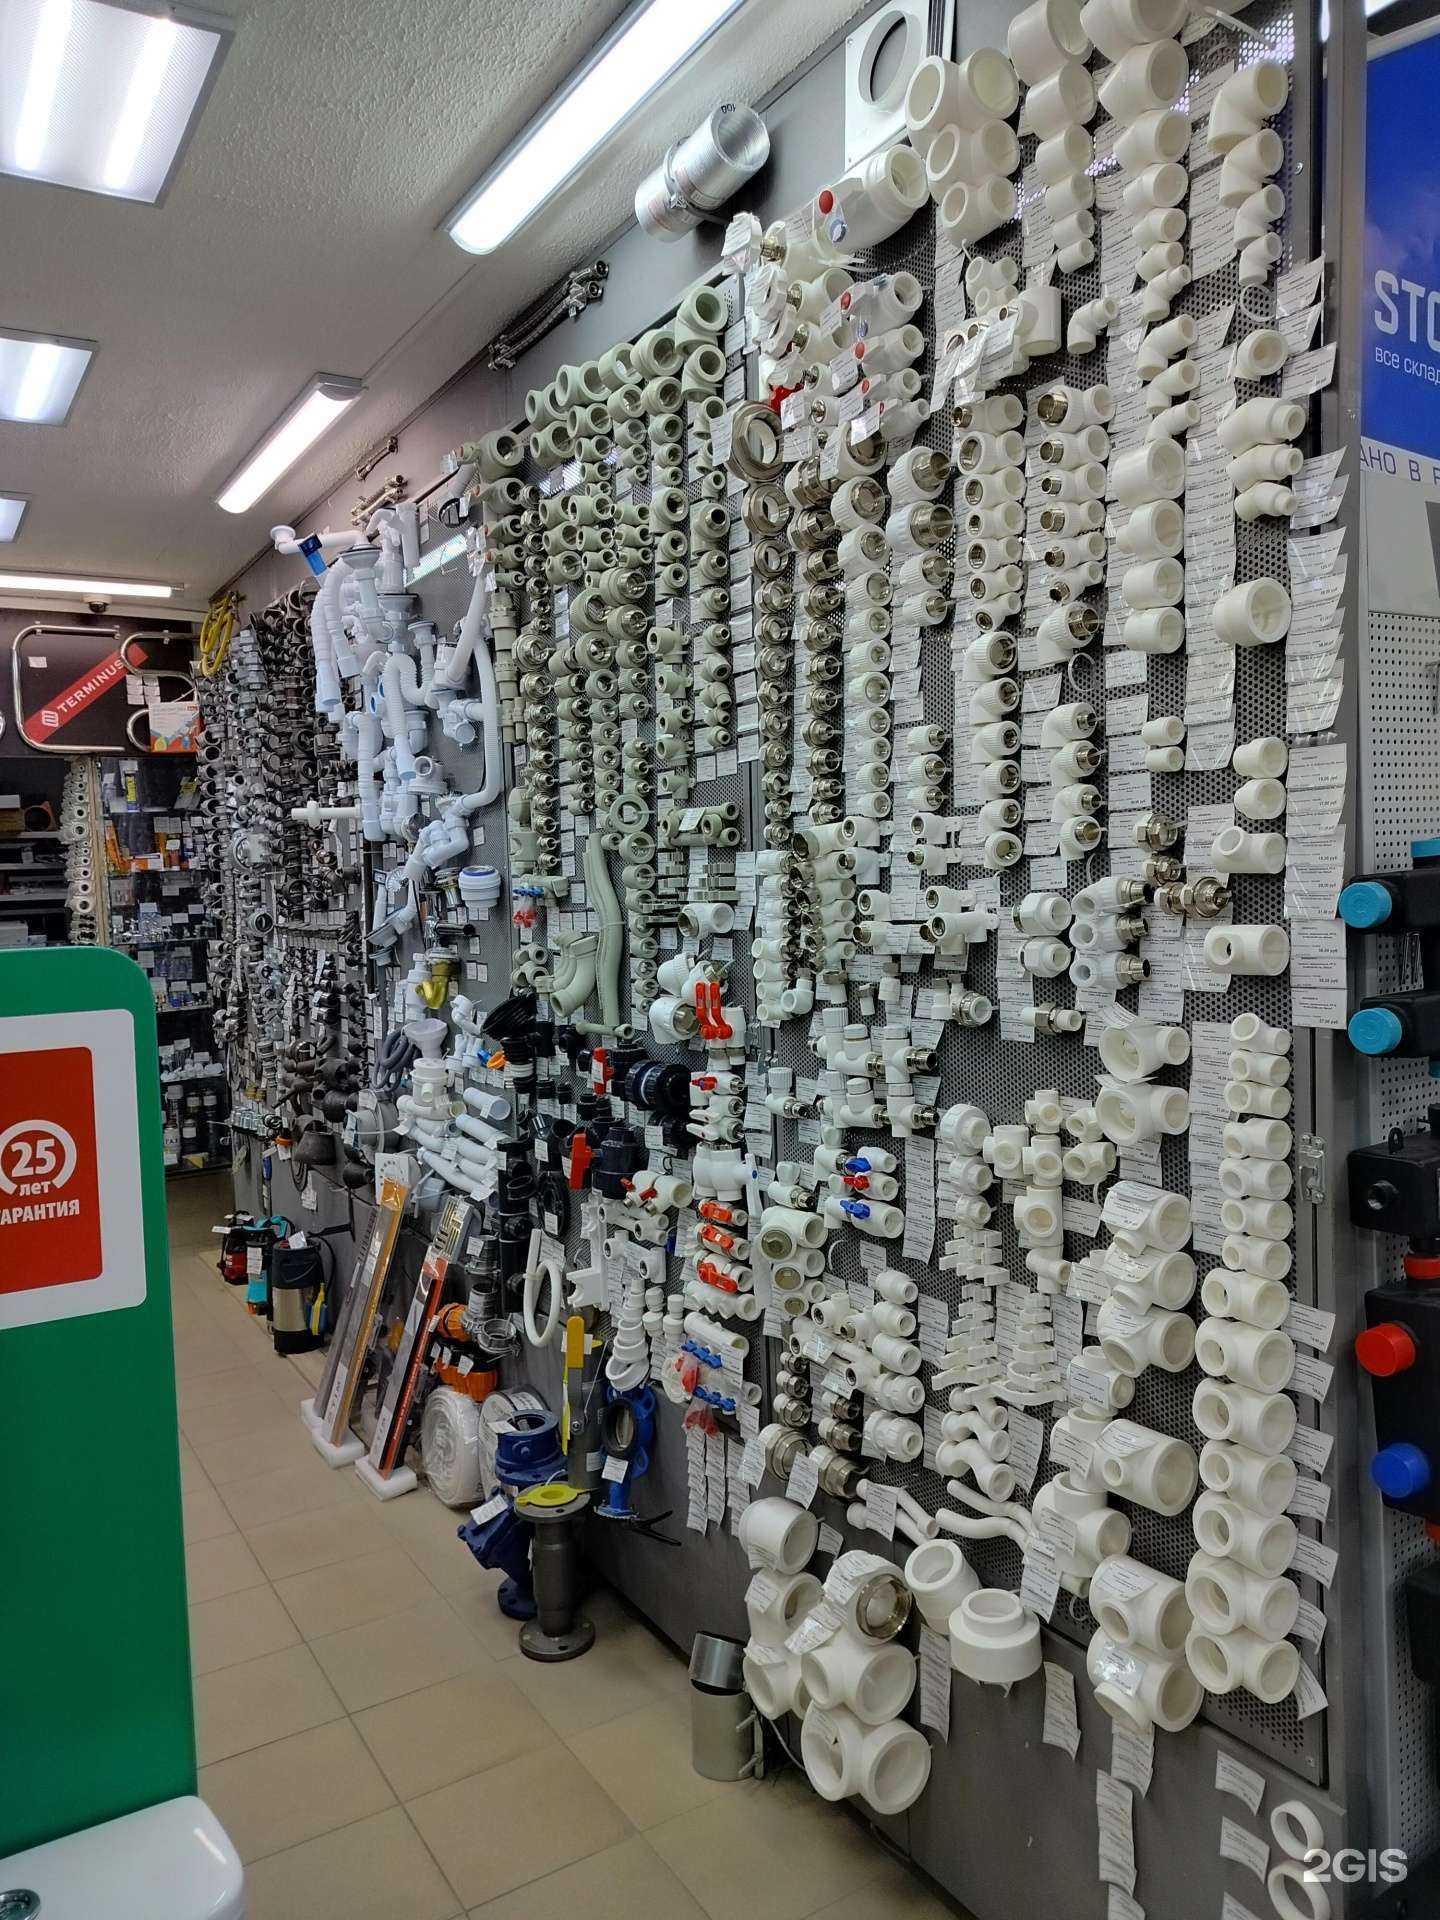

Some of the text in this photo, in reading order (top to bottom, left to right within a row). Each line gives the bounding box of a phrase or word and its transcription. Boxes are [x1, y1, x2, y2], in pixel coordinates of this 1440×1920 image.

[1375, 346, 1400, 369] все
[57, 658, 125, 713] TERMINUS
[11, 1138, 56, 1178] 25
[19, 1180, 52, 1197] лет
[0, 1199, 80, 1226] АРАНТИЯ
